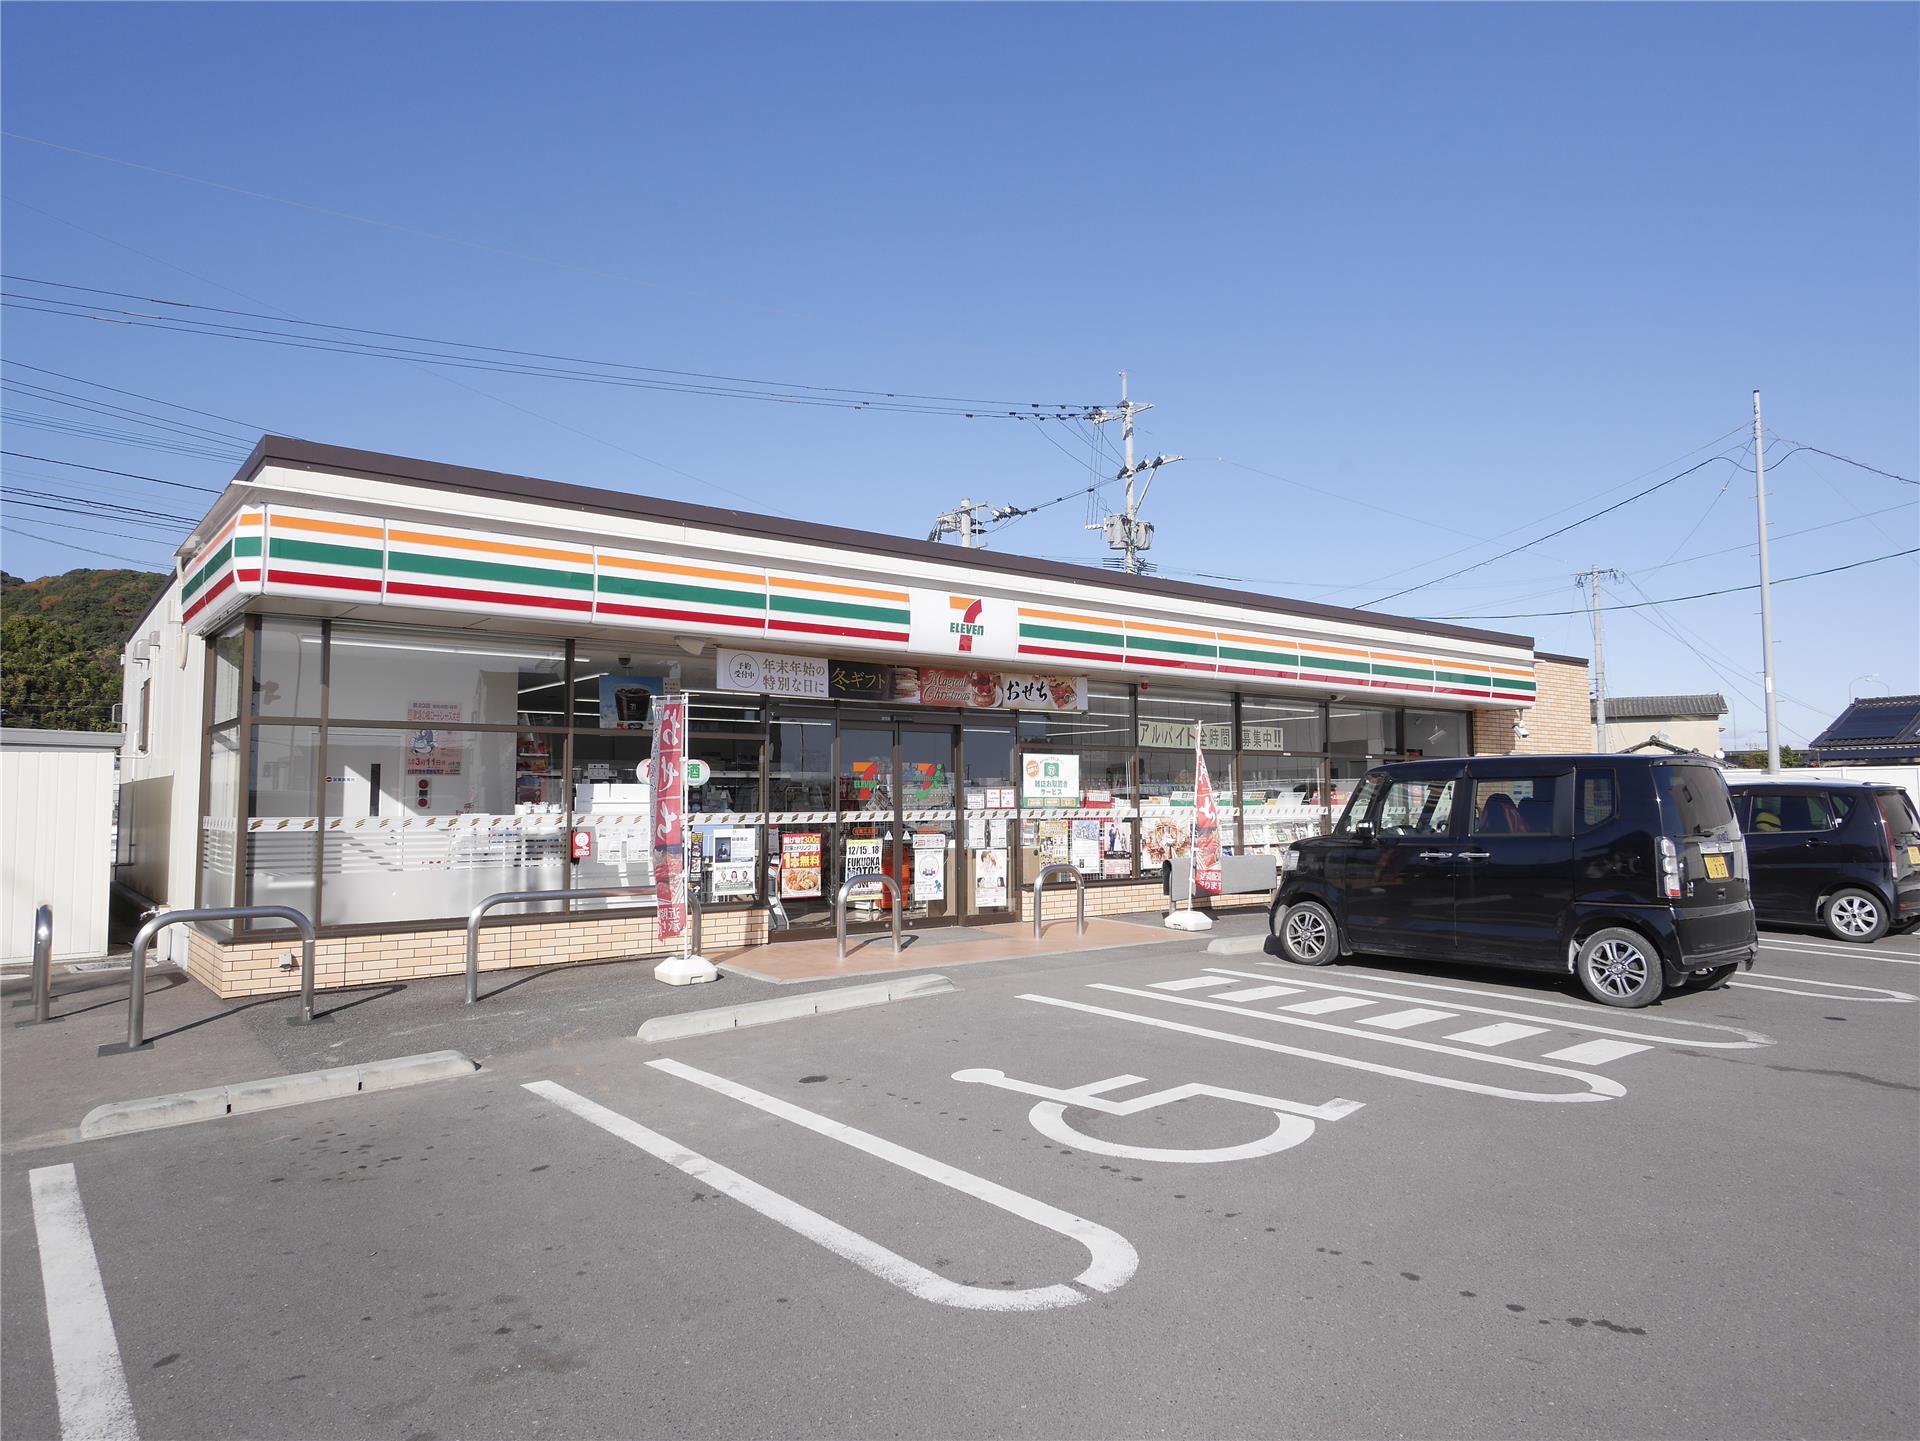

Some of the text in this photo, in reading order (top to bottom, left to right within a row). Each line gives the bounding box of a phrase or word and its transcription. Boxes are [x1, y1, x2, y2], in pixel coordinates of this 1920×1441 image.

[949, 596, 982, 651] 7
[734, 670, 755, 679] 受付中
[738, 662, 752, 670] 予約
[762, 658, 825, 676] 年末年始の
[762, 675, 825, 693] 特別な日に
[831, 667, 886, 691] 冬ギフト
[924, 670, 968, 688] Magical
[924, 685, 972, 702] Christmas
[1006, 680, 1048, 702] おせち
[847, 856, 880, 867] FUKUOKA
